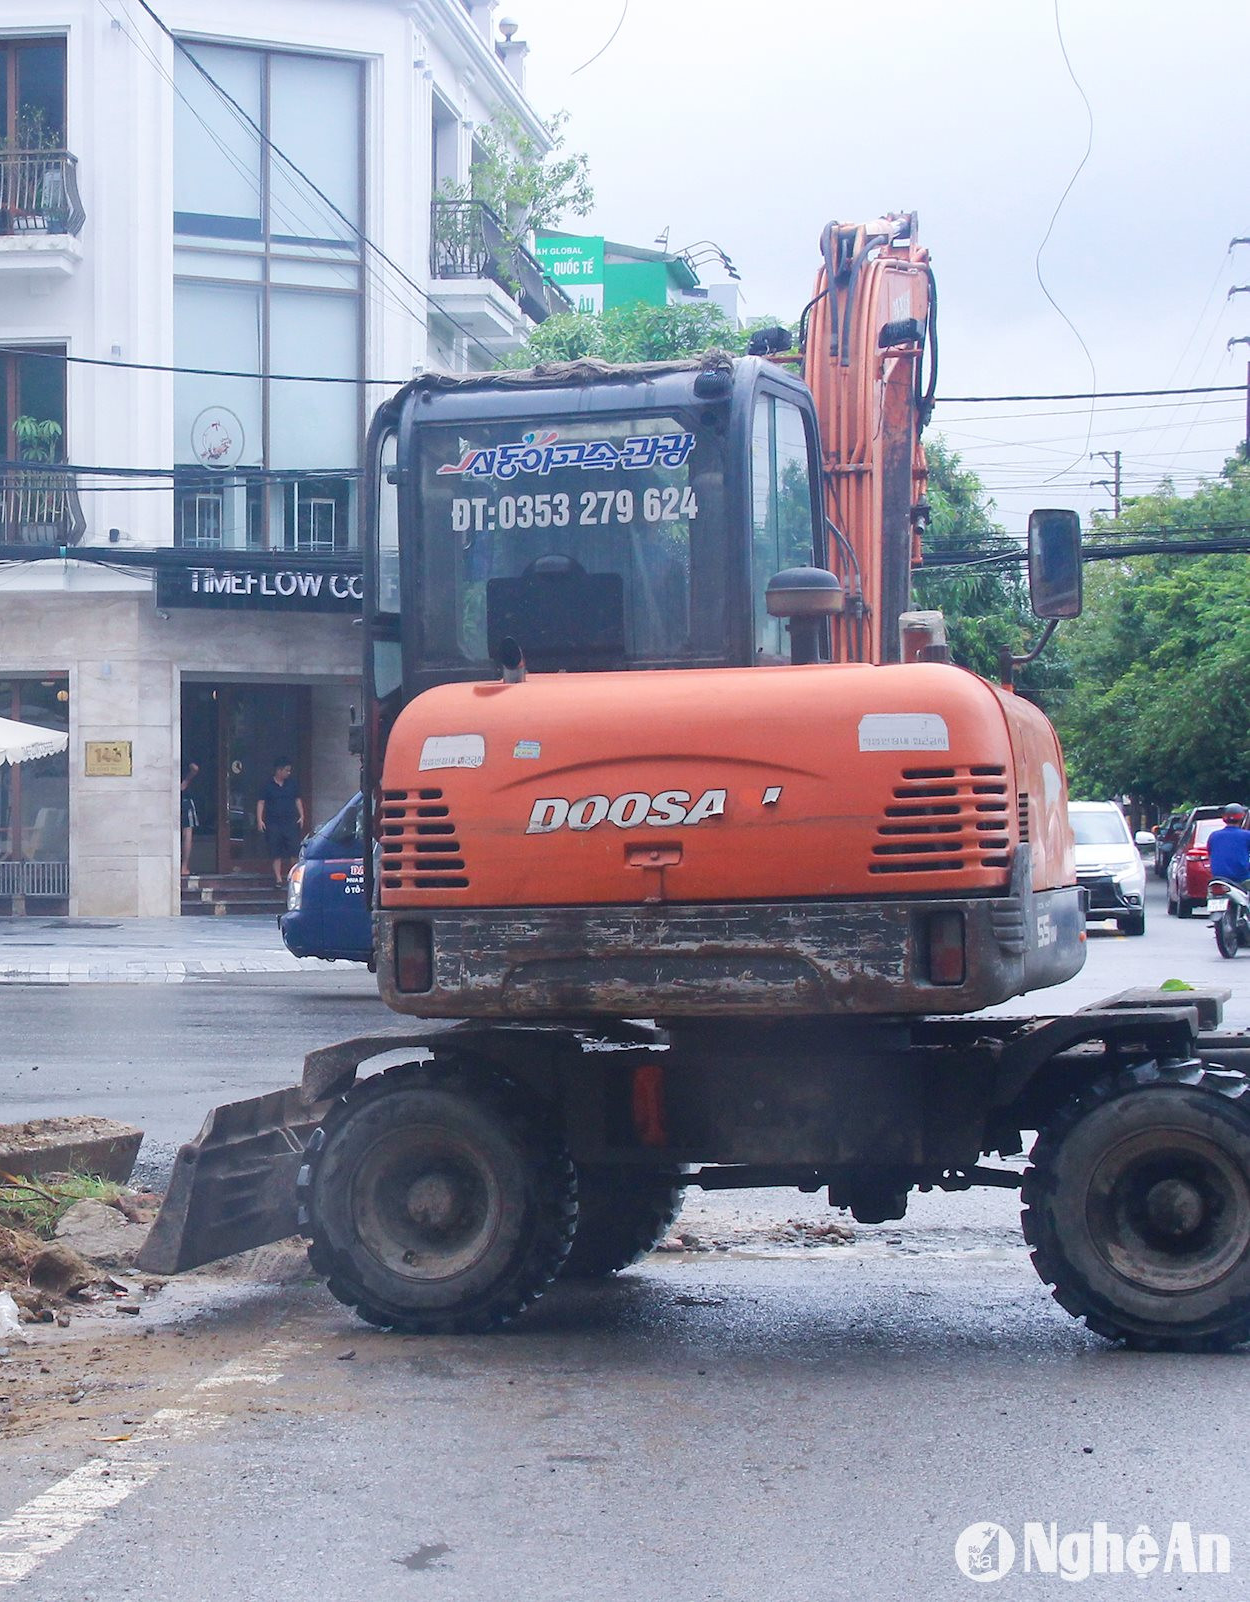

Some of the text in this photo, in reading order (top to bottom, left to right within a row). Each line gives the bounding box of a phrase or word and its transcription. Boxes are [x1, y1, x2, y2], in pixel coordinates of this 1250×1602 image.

[550, 247, 583, 255] GLOBAL
[553, 257, 580, 276] QUỐC
[582, 256, 595, 274] TẾ
[451, 486, 699, 531] ĐT:0353 279 624
[187, 567, 323, 597] TIMEFLOW
[525, 786, 783, 835] DOOSA
